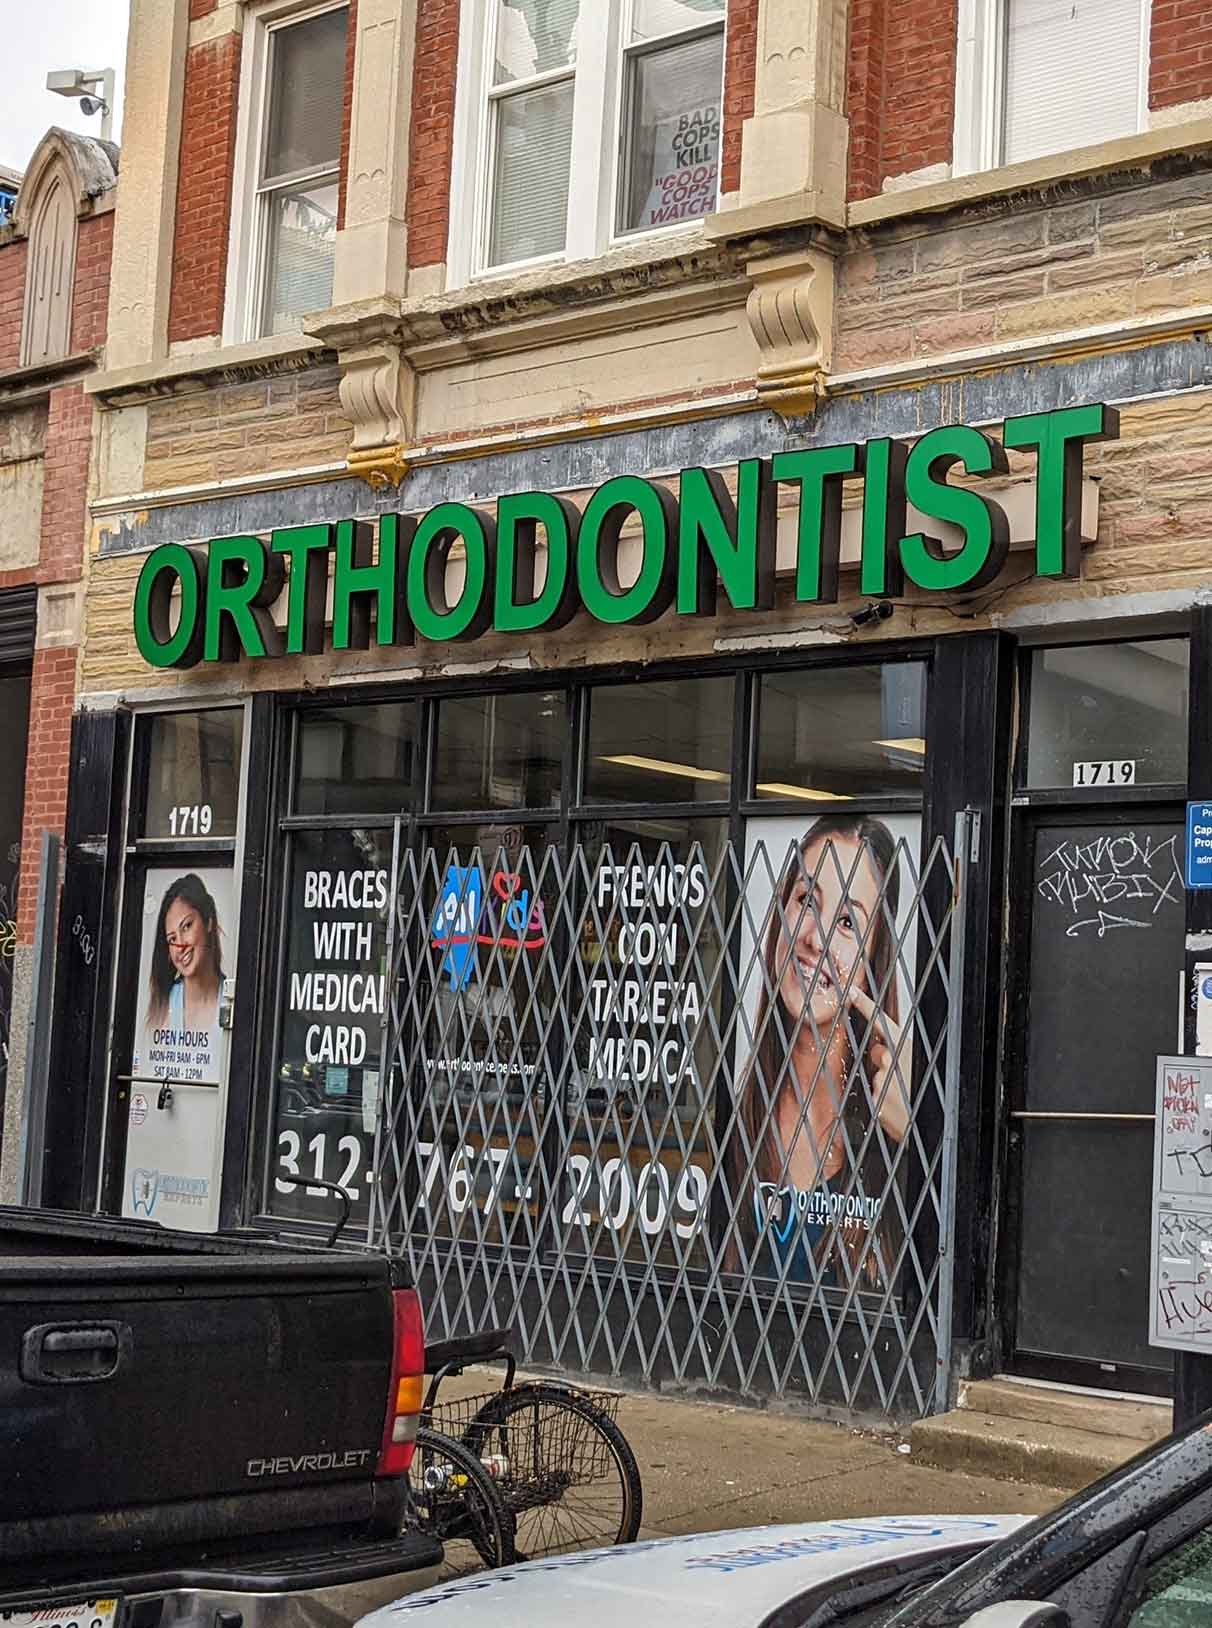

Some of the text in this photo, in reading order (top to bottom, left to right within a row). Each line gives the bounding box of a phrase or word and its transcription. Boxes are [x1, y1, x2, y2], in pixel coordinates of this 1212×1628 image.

[678, 107, 717, 131] BAD
[672, 122, 720, 151] COPS
[676, 143, 712, 169] KILL
[662, 181, 711, 206] COPS
[134, 402, 1108, 667] ORTHODONTIST
[1076, 761, 1133, 785] 1719
[168, 804, 212, 836] 1719
[1194, 837, 1212, 848] Pro
[304, 869, 388, 909] BRACES
[598, 864, 706, 908] FRENOS
[313, 921, 372, 961] WITH
[618, 922, 678, 966] CON
[591, 979, 701, 1025] TARJETA
[153, 1029, 209, 1048] OPEN HOURS
[305, 1024, 367, 1065] CARD
[588, 1038, 697, 1085] MEDICA
[562, 1155, 708, 1239] 2009
[807, 1213, 870, 1231] EXPRTS
[247, 1449, 370, 1477] CHEVROLET
